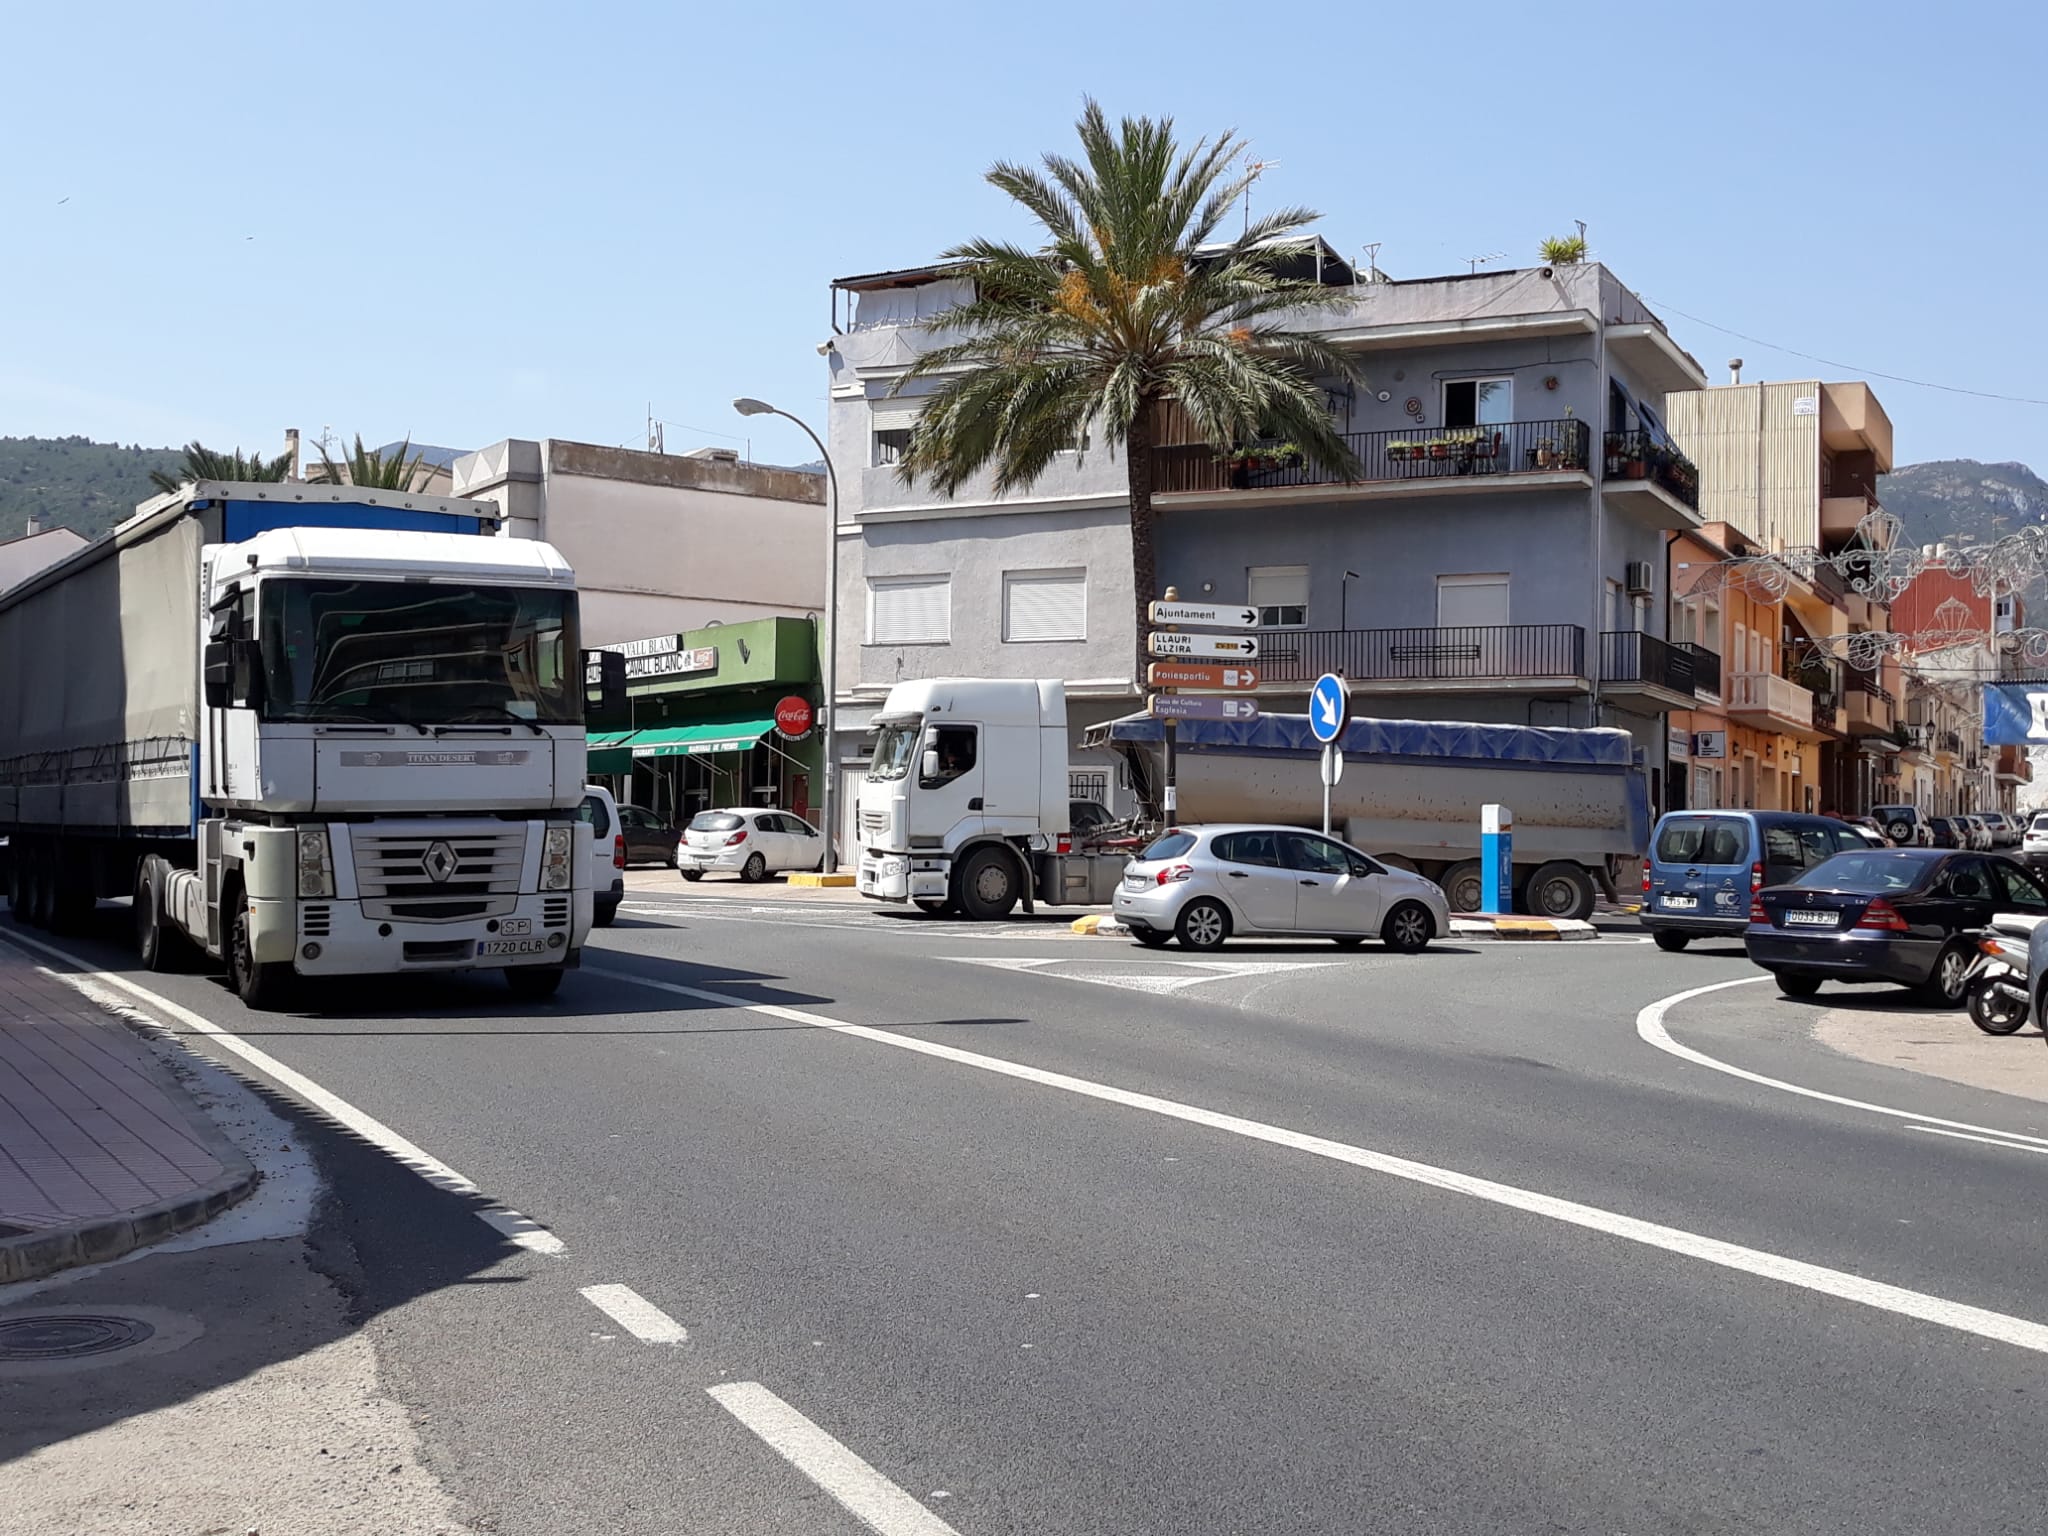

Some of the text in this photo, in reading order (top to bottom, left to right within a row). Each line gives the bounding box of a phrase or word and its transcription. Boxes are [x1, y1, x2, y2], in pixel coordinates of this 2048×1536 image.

[1156, 607, 1216, 619] Ajuntament
[649, 635, 676, 652] BLANC
[1156, 634, 1191, 644] LLAURI
[1156, 644, 1192, 653] ALZIRA
[625, 657, 653, 677] CAVALL
[654, 653, 683, 674] BLANC
[408, 753, 476, 763] TITAN DESERT
[1791, 911, 1814, 921] 0033
[487, 940, 543, 954] 1720 CLR
